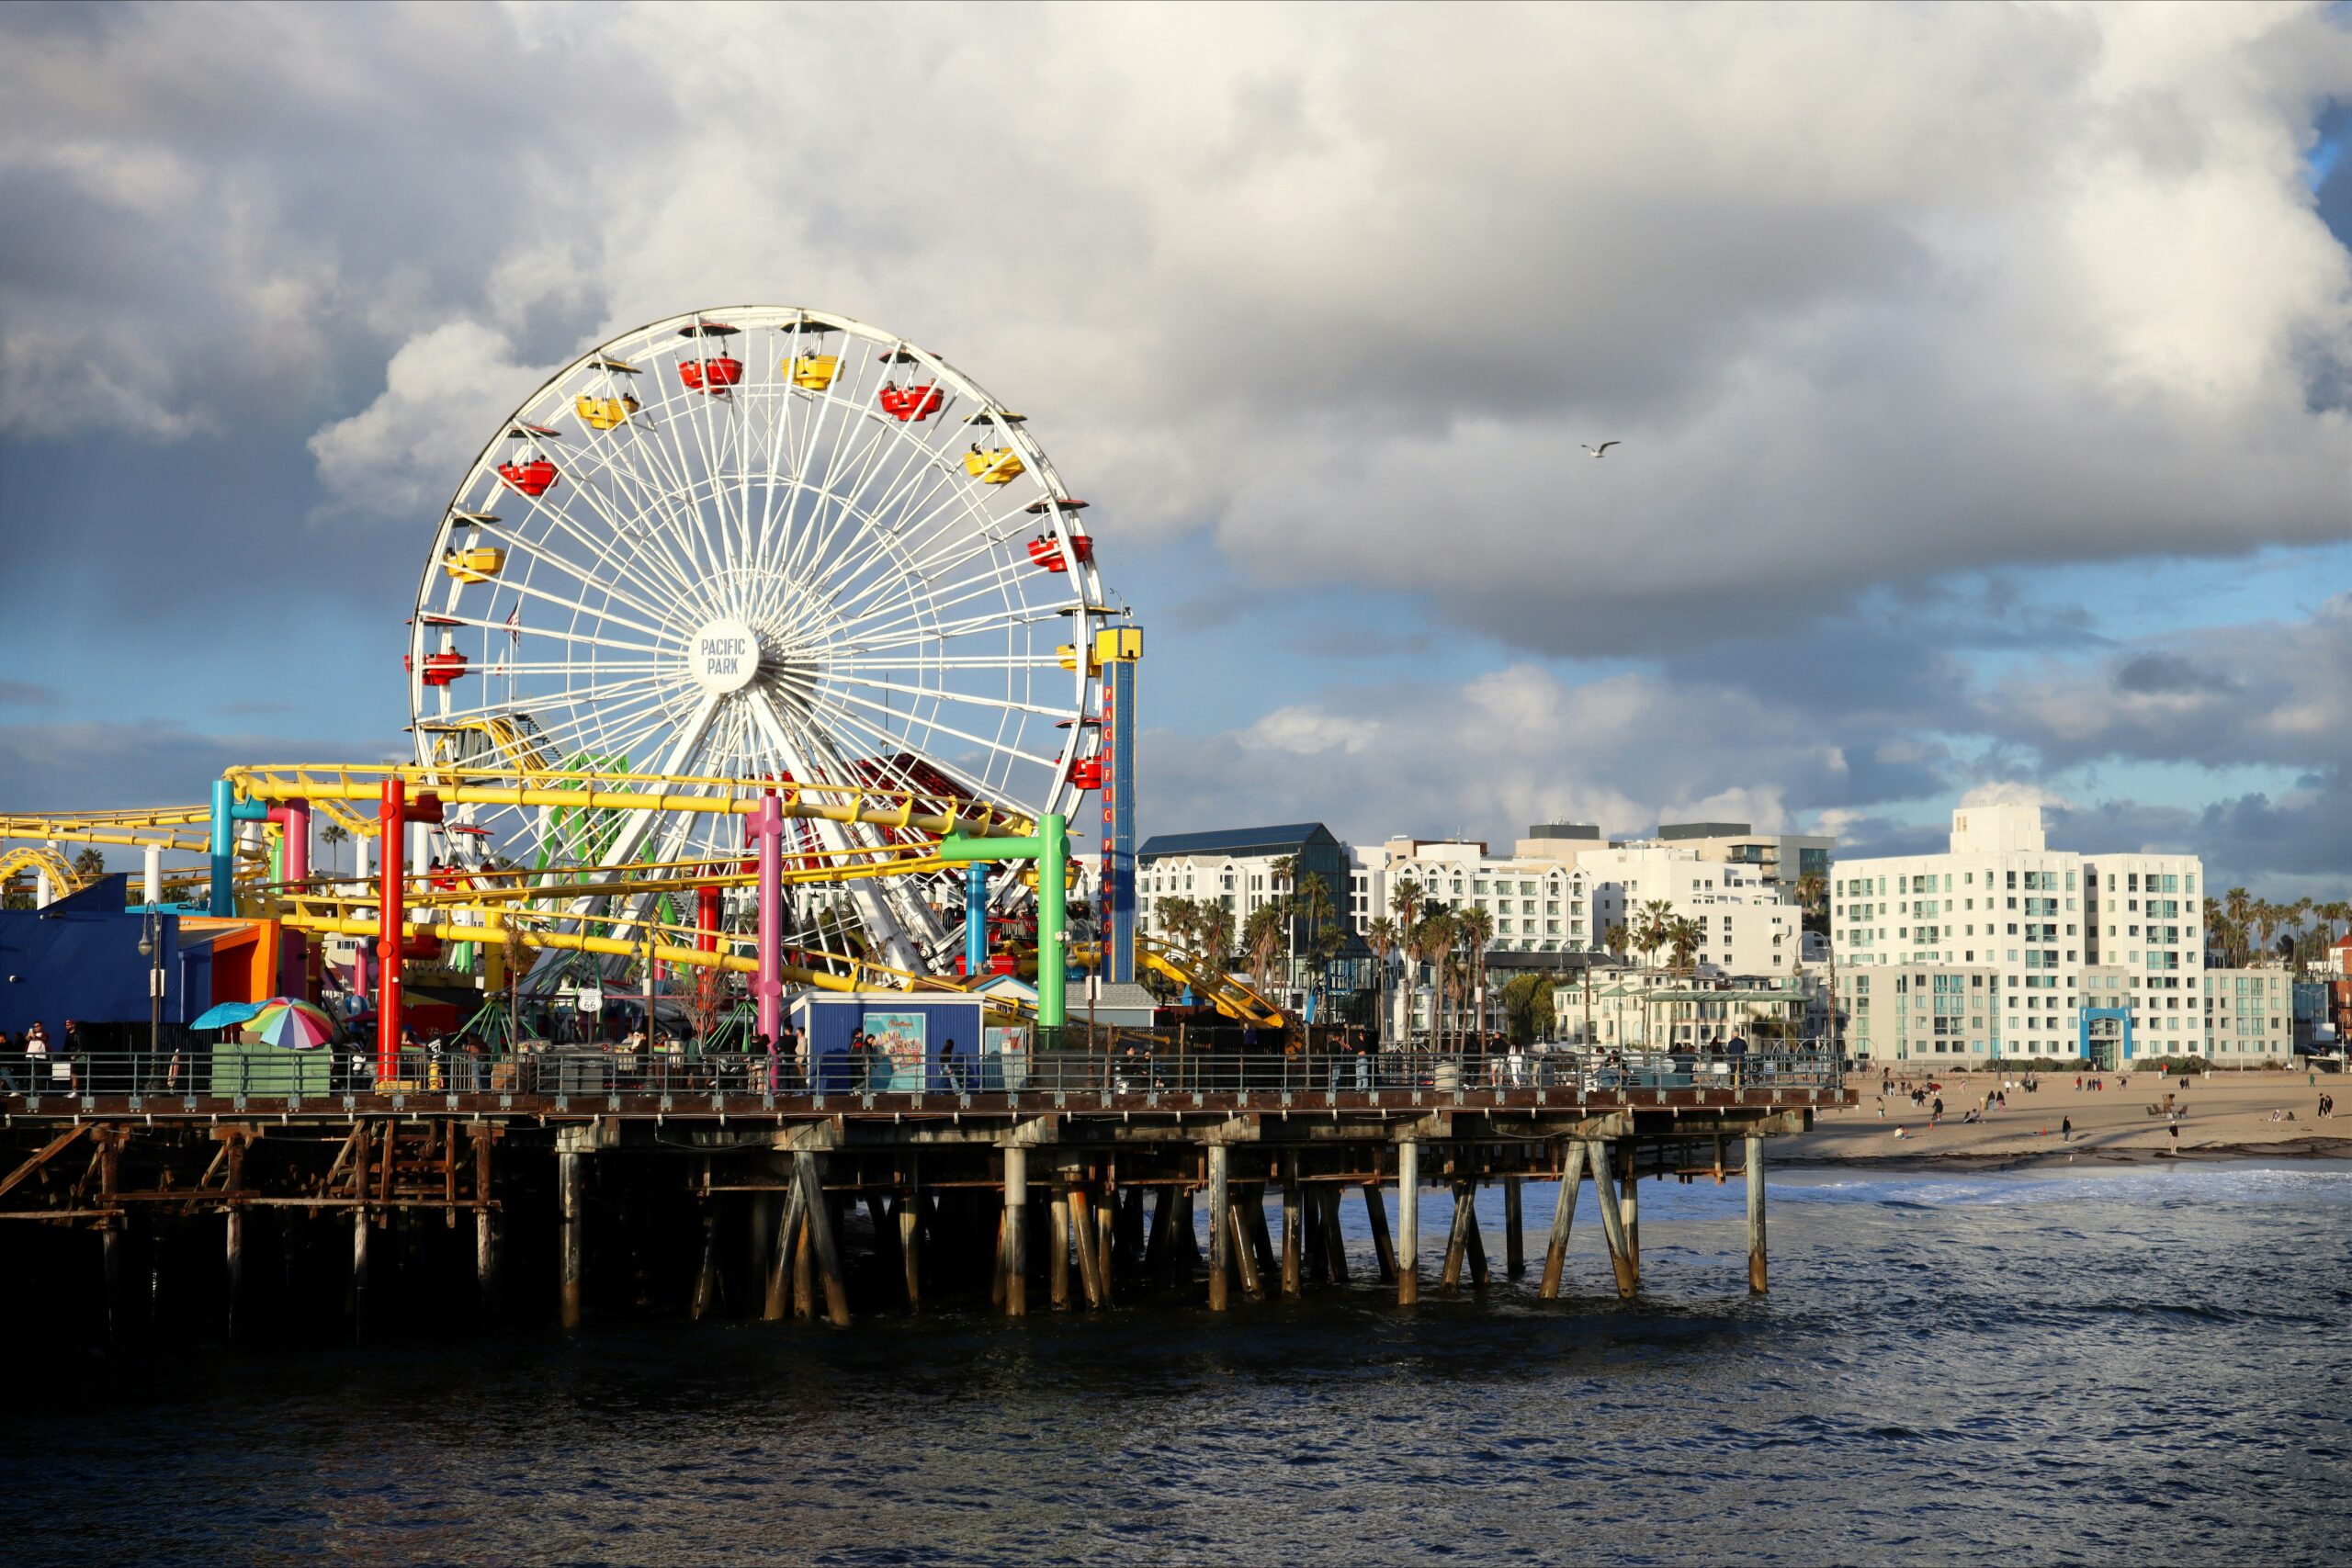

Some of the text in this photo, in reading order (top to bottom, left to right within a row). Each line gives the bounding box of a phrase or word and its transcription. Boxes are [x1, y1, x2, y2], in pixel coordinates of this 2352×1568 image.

[701, 638, 745, 656] PACIFIC
[707, 658, 738, 675] PARK
[584, 1001, 595, 1010] 66
